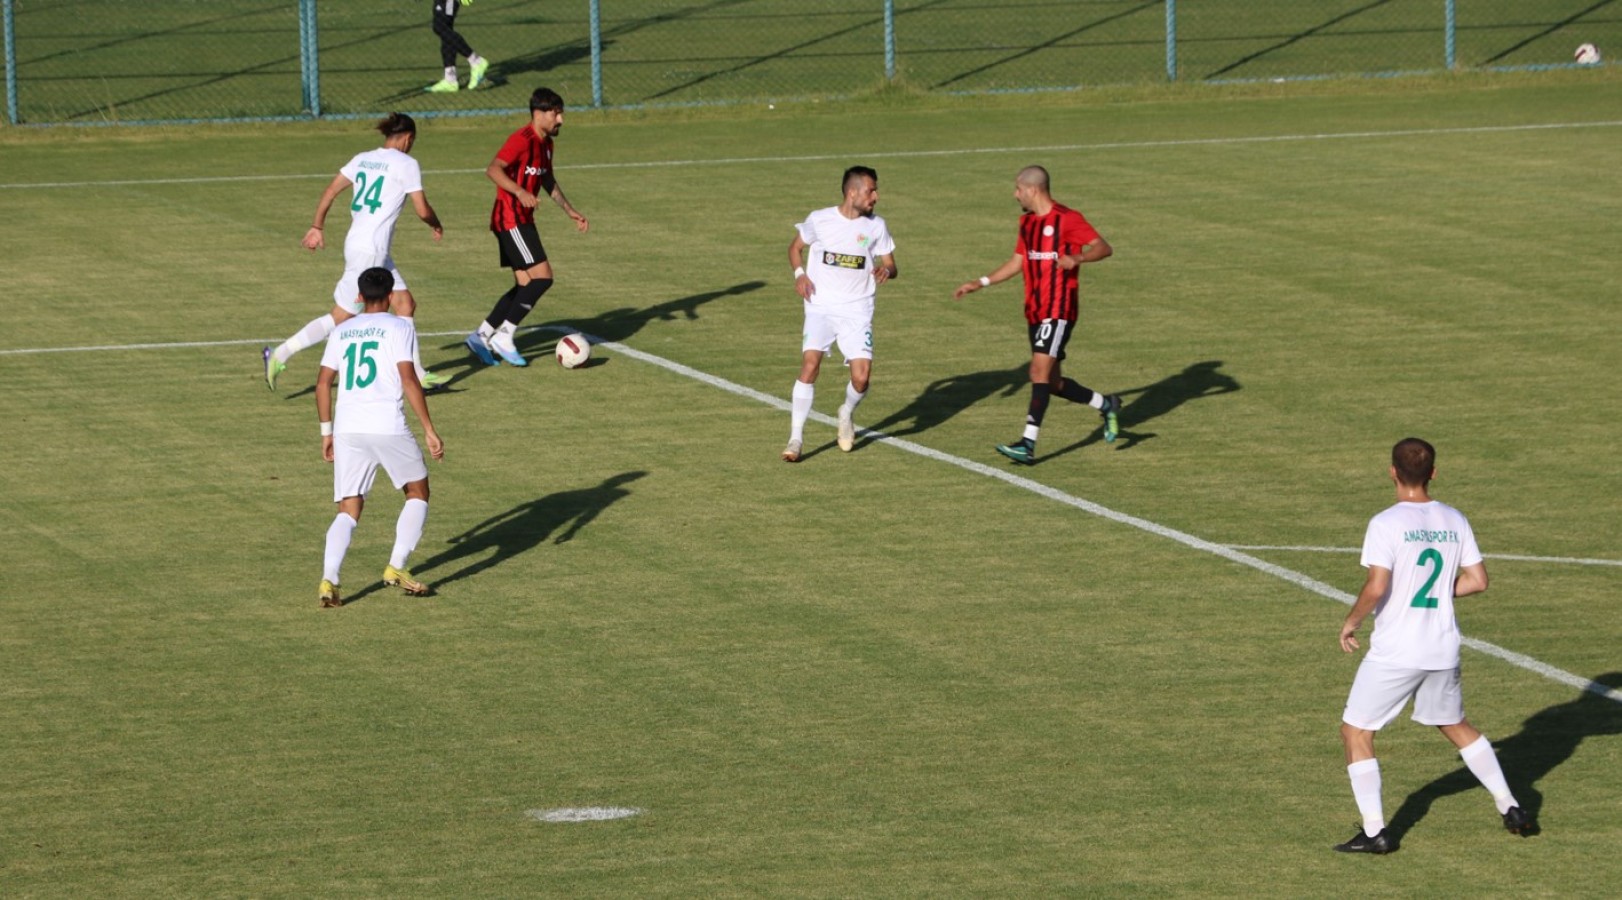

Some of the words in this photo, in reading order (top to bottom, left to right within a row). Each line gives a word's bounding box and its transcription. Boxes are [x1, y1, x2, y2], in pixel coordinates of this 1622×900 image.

[351, 171, 385, 215] 24
[864, 331, 873, 347] 3
[342, 340, 379, 391] 15
[1410, 547, 1444, 609] 2
